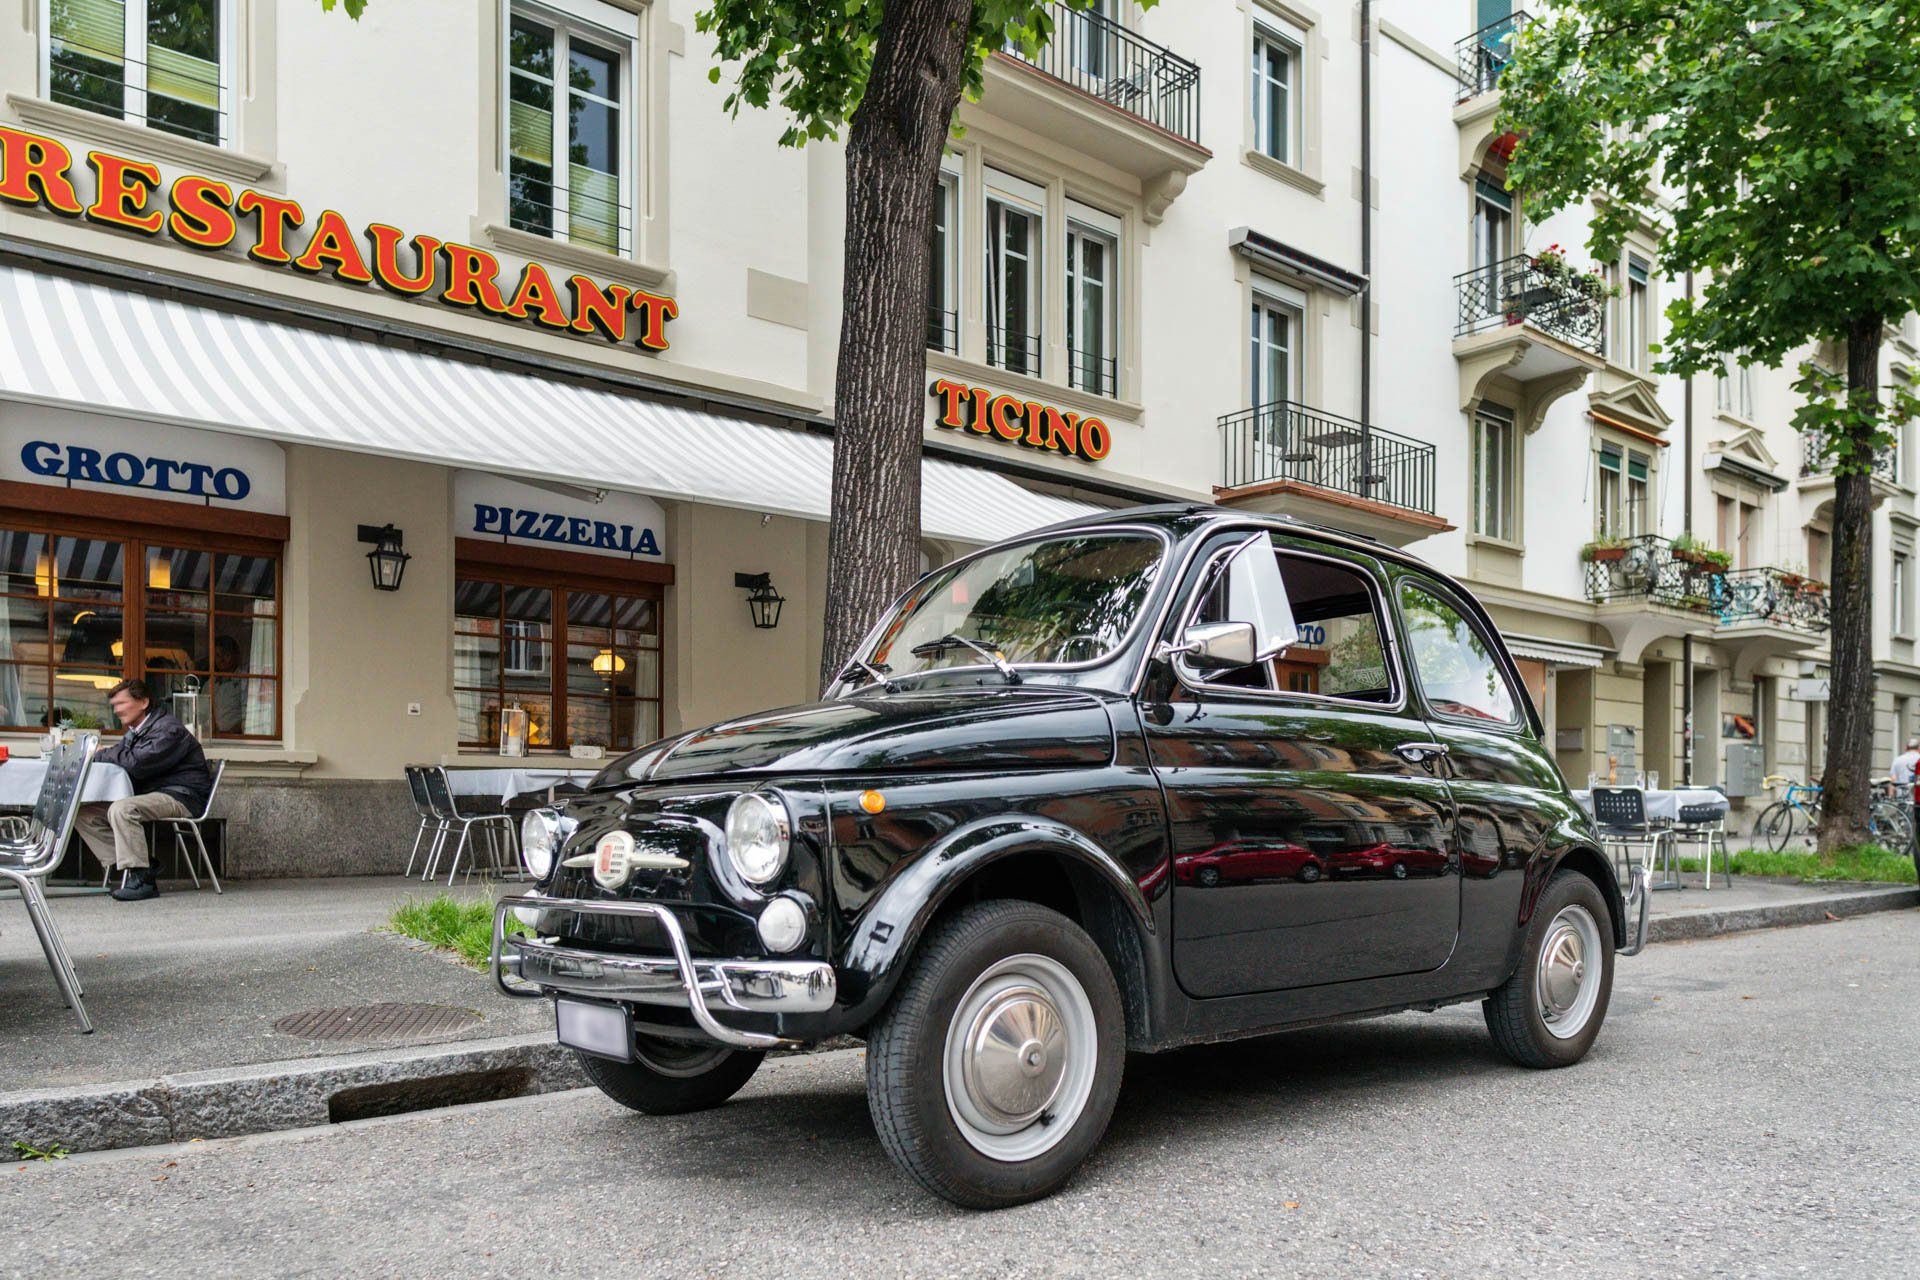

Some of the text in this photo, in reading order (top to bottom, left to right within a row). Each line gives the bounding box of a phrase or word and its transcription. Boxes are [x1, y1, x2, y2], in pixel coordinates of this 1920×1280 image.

[0, 126, 679, 352] RESTAURANT
[931, 378, 1112, 461] TICINO
[20, 440, 251, 501] GROTTO
[473, 503, 662, 556] PIZZERIA
